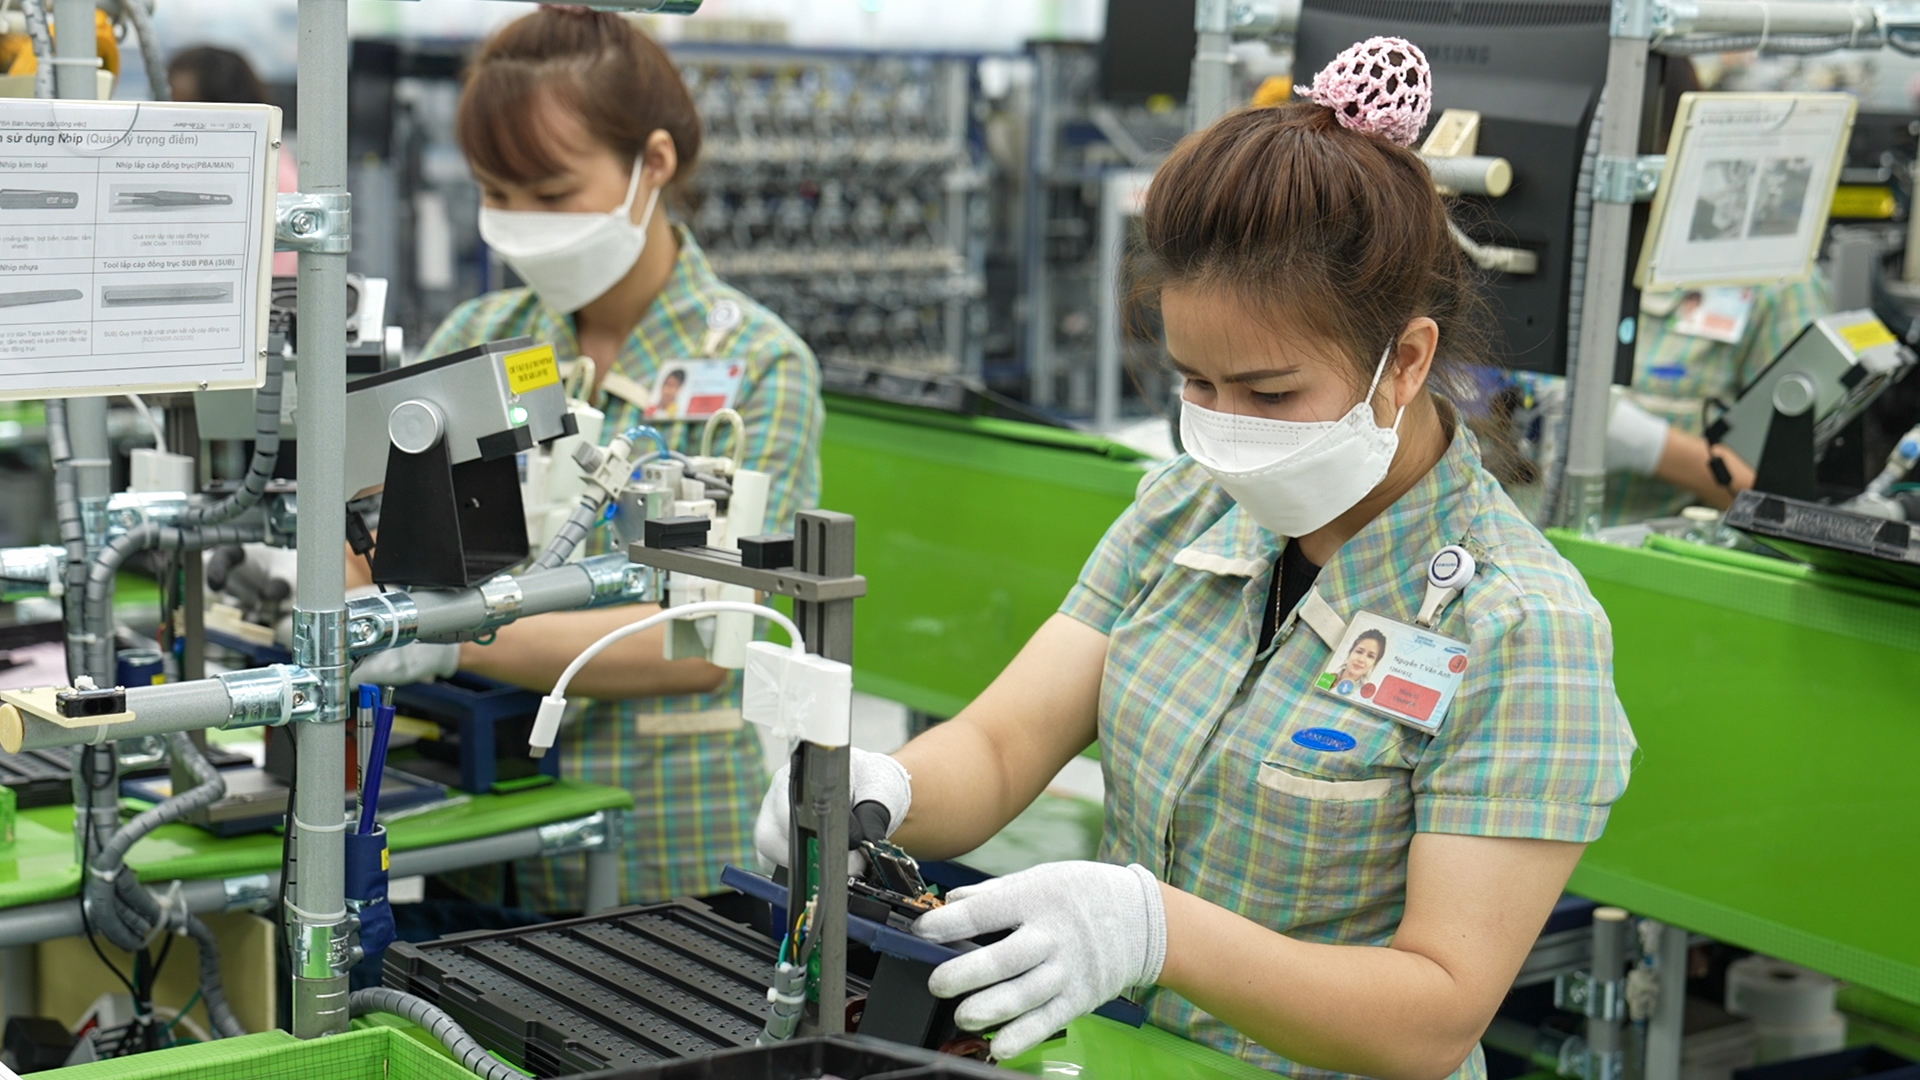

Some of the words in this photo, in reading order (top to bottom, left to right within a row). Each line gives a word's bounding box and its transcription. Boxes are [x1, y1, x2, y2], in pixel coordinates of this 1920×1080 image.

[1419, 43, 1490, 65] MSUNG
[6, 132, 23, 144] sử
[25, 133, 55, 146] dụng
[136, 134, 166, 146] trọng
